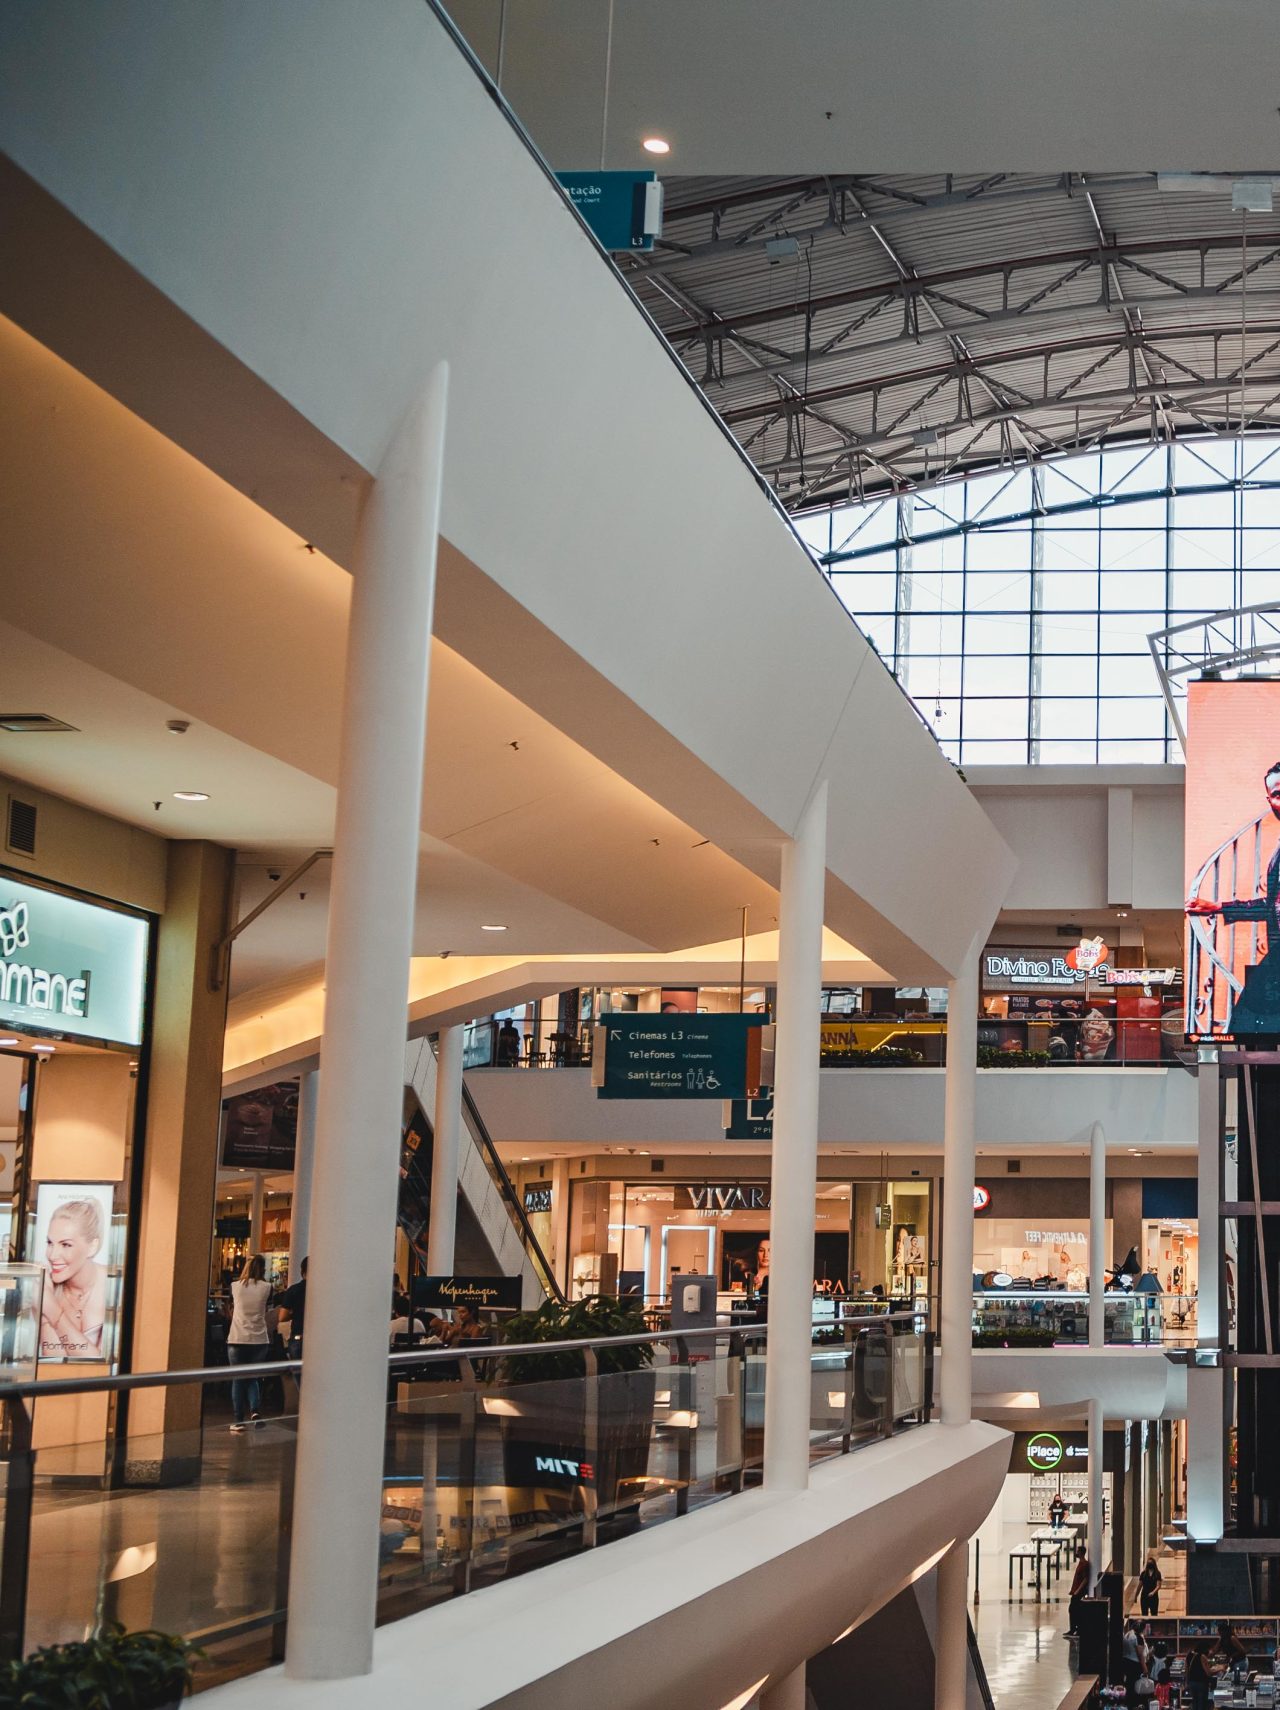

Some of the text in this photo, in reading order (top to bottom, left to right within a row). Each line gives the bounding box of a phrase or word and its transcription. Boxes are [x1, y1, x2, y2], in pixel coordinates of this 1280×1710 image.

[988, 957, 1109, 981] Divino Fogo
[629, 1032, 667, 1040] Cinemas
[671, 1031, 683, 1040] L3
[628, 1051, 675, 1059] Telefones
[628, 1071, 683, 1080] Sanitários
[747, 1089, 759, 1097] L2
[686, 1186, 771, 1209] VIVAR
[439, 1279, 498, 1303] Kopenhagen
[1027, 1446, 1060, 1456] iPlace
